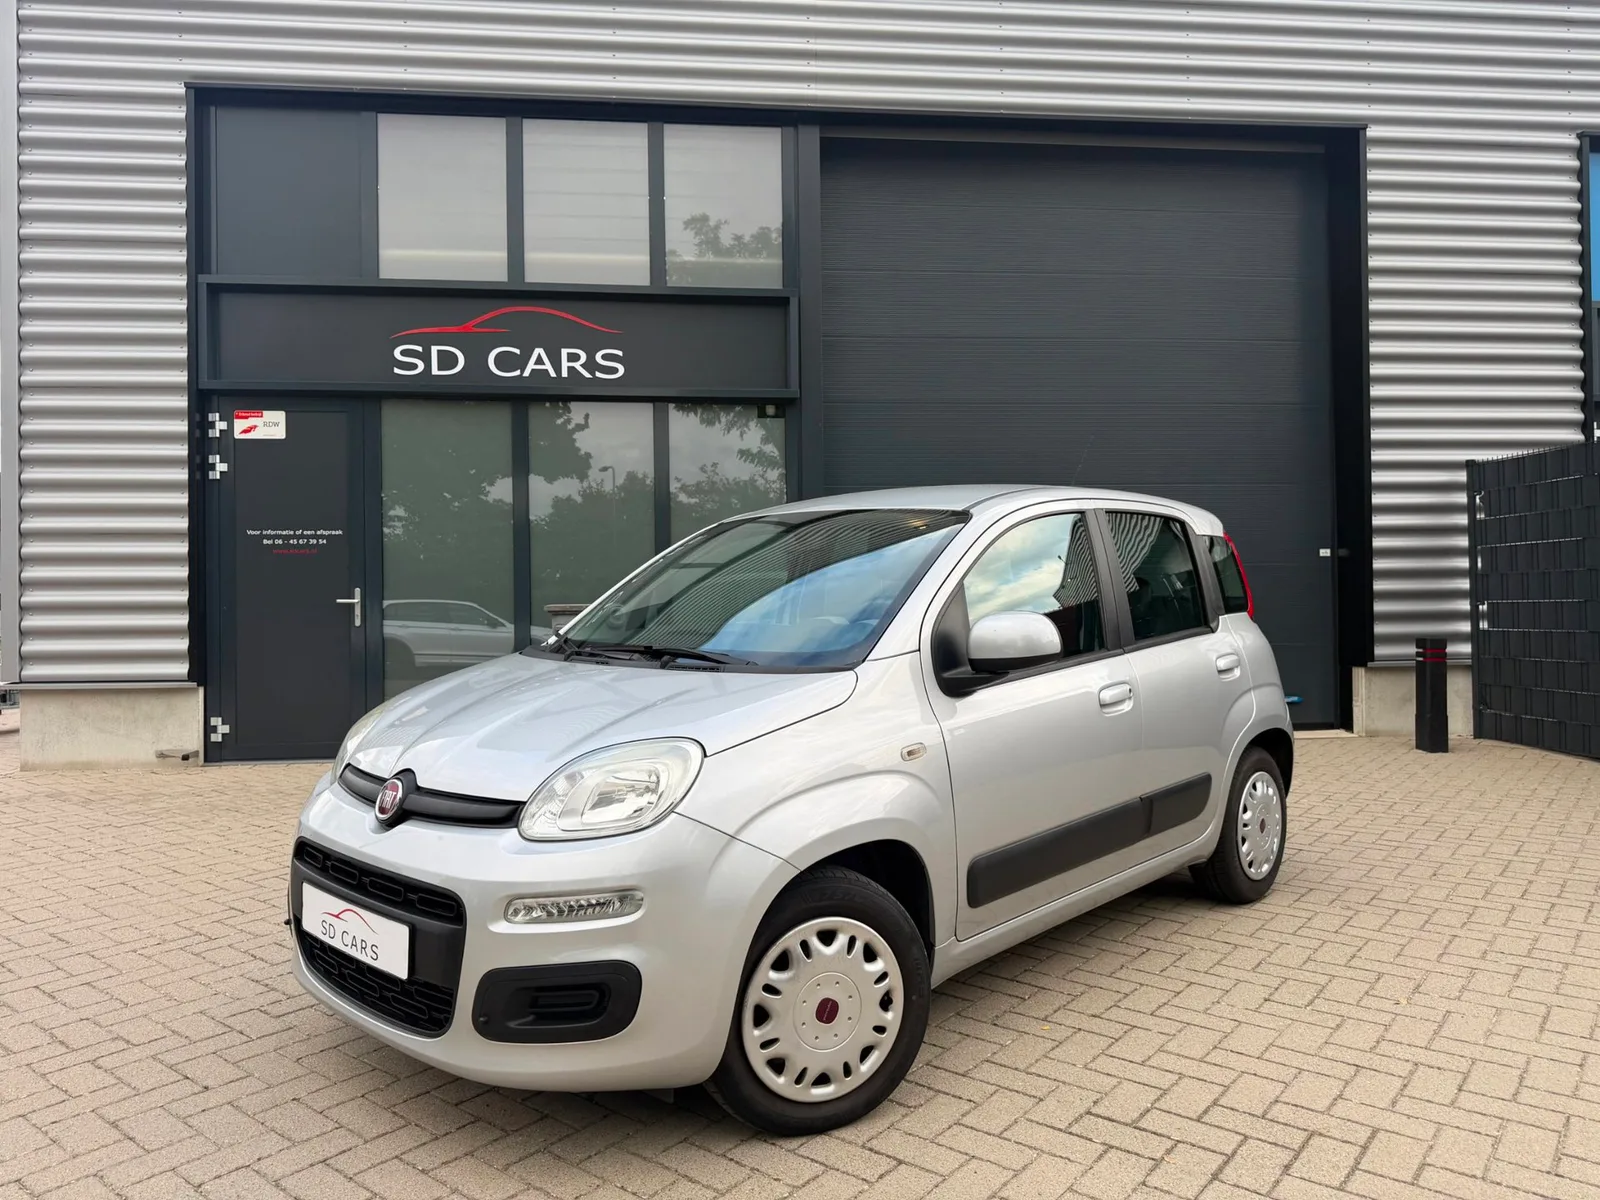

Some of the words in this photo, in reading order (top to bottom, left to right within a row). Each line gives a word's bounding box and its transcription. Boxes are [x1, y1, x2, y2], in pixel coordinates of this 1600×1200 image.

[393, 344, 465, 376] SD
[487, 346, 625, 379] CARS
[380, 790, 396, 808] FIAT
[321, 919, 336, 940] SD
[341, 930, 379, 961] CARS
